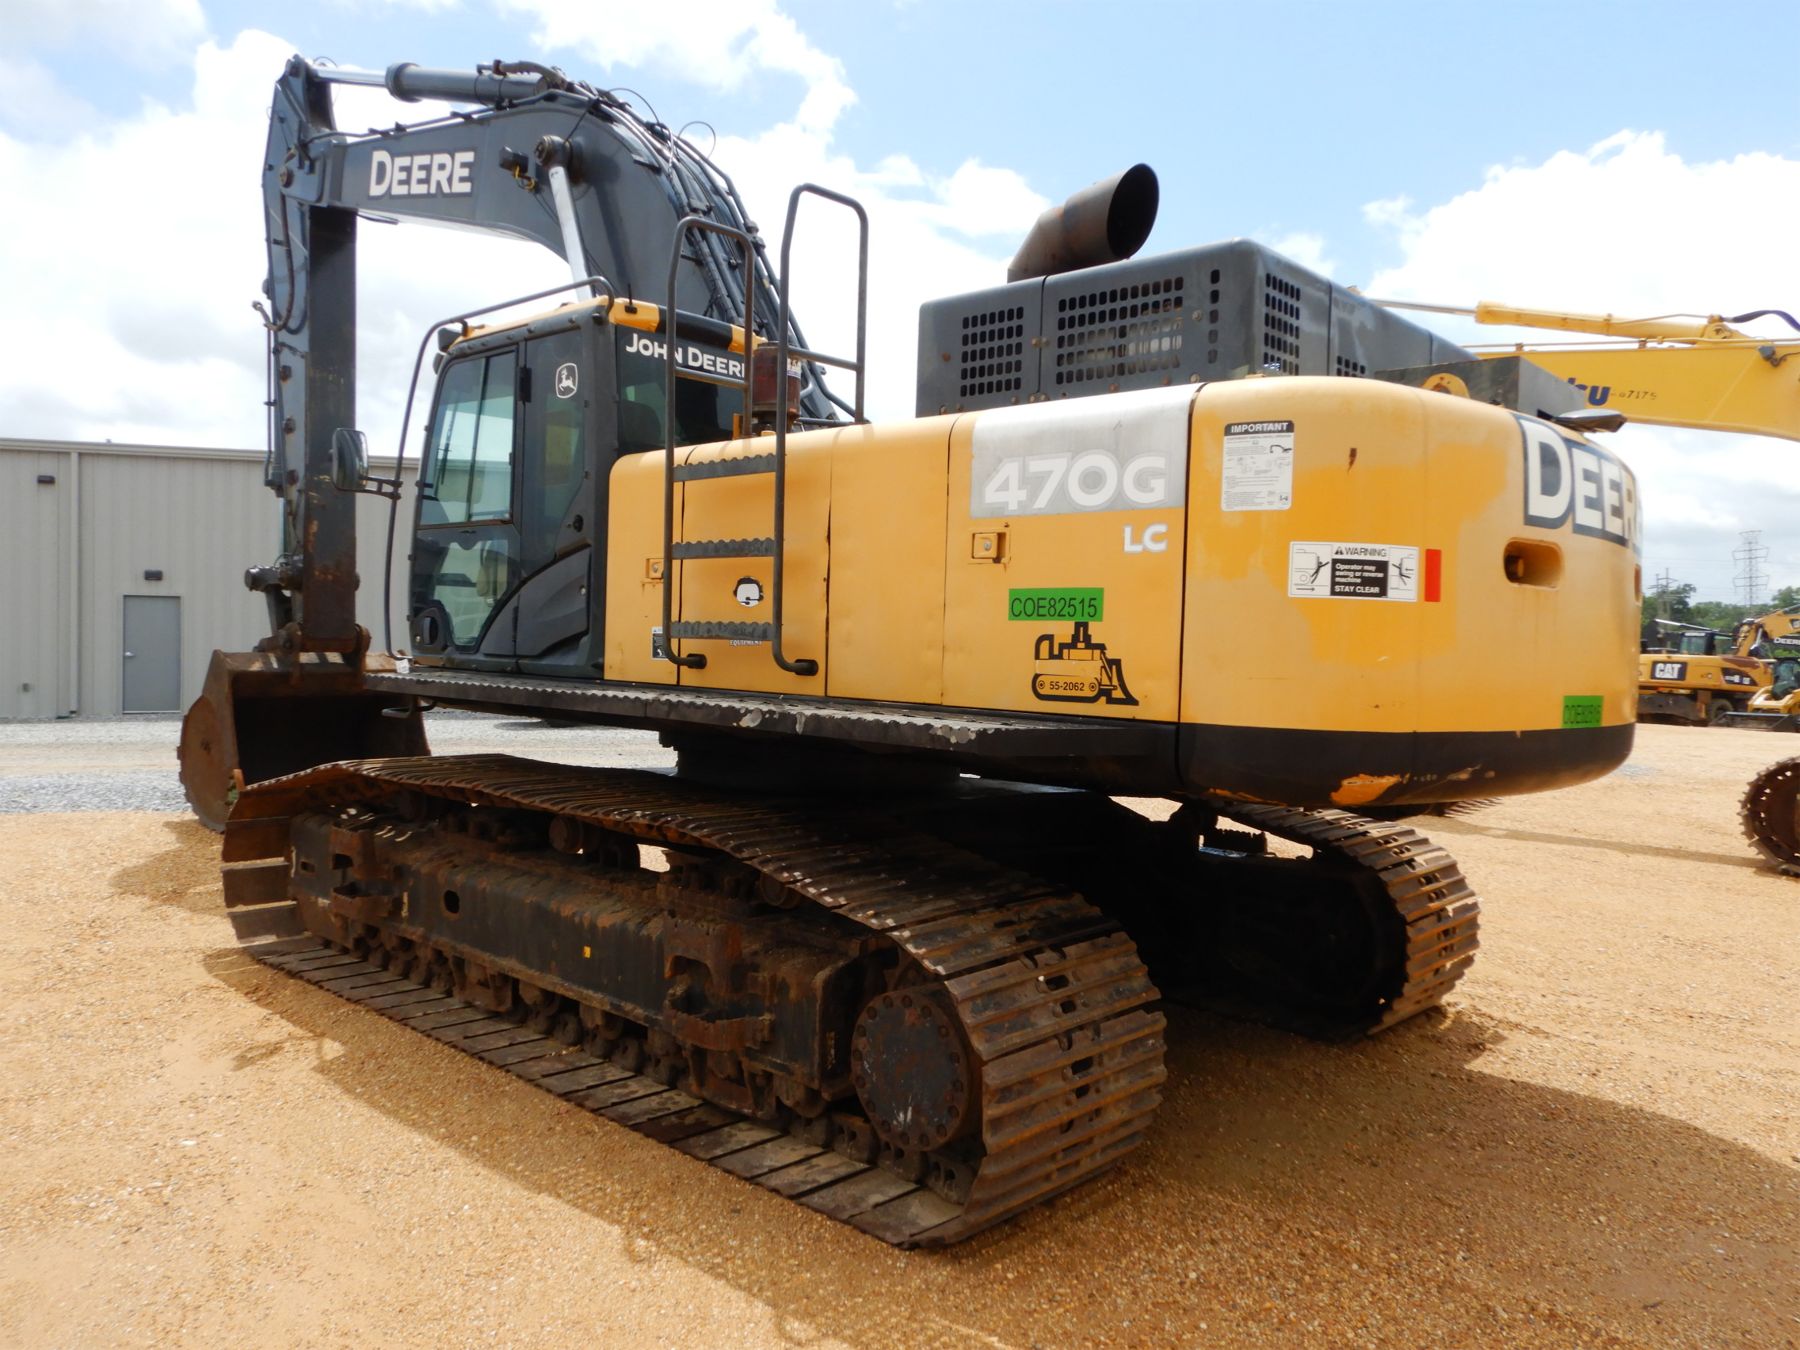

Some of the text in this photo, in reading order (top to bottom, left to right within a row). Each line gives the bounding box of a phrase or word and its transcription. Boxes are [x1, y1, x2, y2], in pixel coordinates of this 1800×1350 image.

[368, 150, 475, 196] DEERE
[687, 346, 745, 378] DEER
[1230, 422, 1289, 434] IMPORTANT
[984, 453, 1168, 512] 470G
[1123, 524, 1168, 553] LC
[1344, 547, 1387, 557] WARNING
[1335, 563, 1362, 571] Operator
[1355, 586, 1380, 594] CLEAR
[1655, 663, 1683, 679] CAT
[1050, 681, 1085, 692] 55-2062
